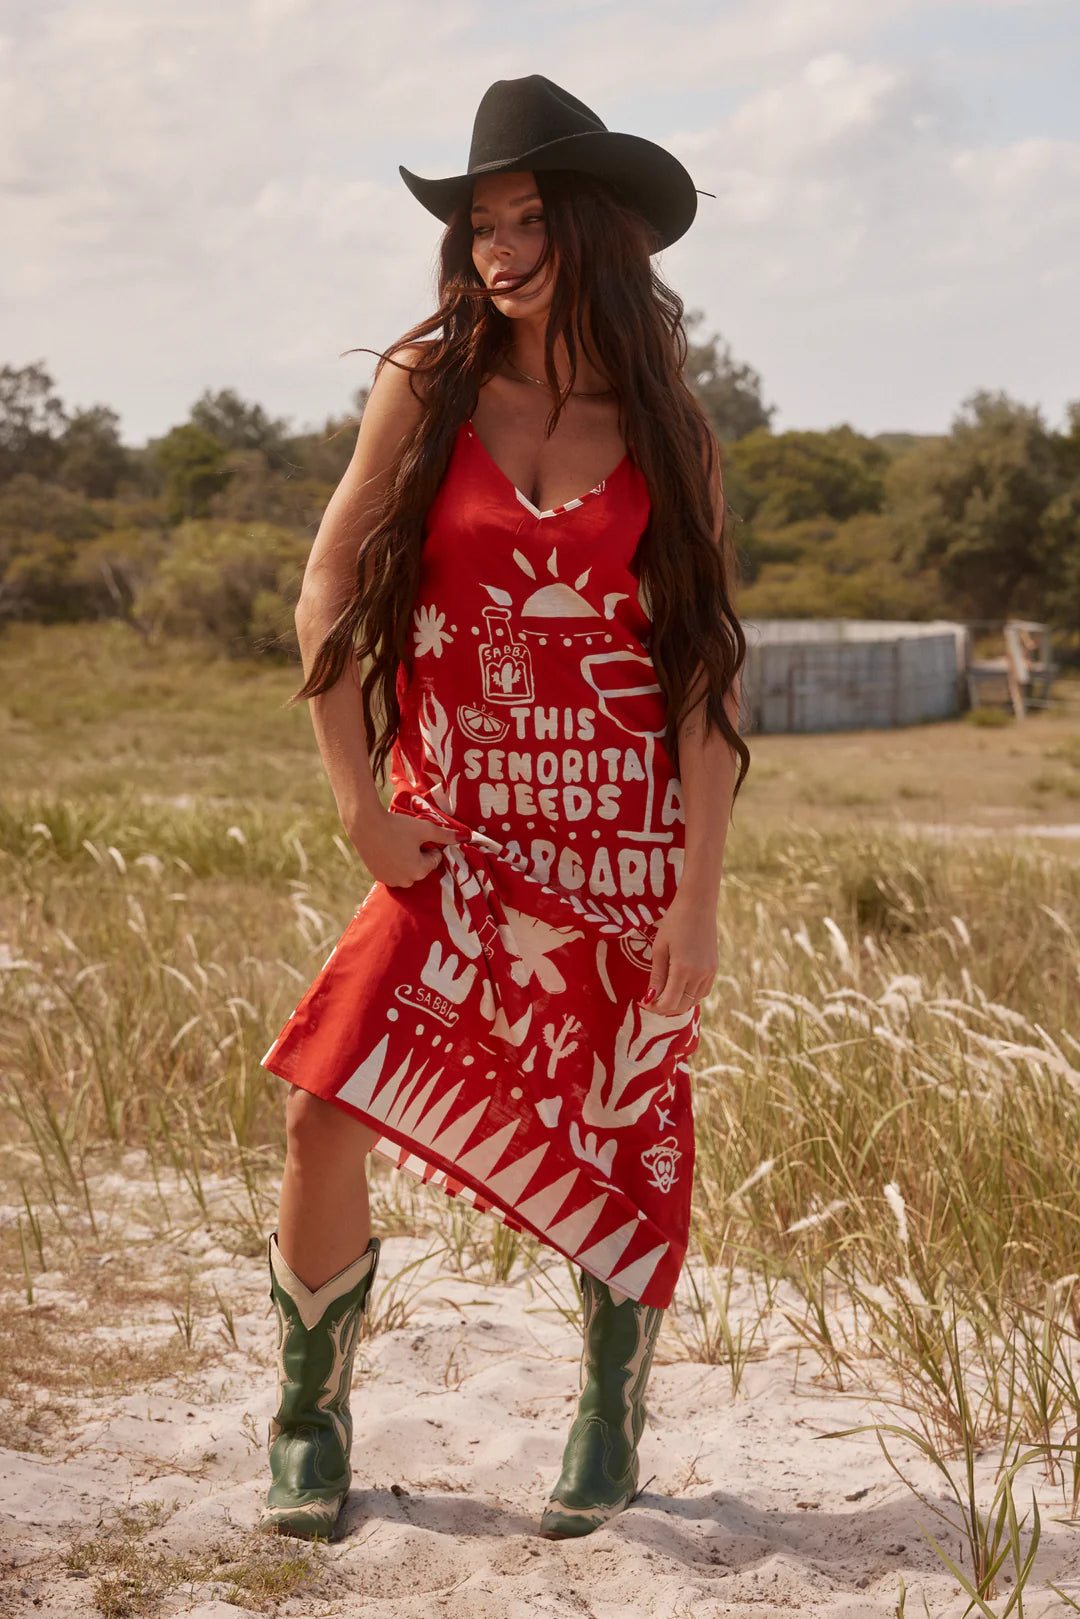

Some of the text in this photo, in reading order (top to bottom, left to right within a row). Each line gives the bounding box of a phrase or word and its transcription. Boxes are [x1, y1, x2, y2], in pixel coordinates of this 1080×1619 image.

[484, 645, 527, 661] SABBI
[510, 706, 596, 741] THIS
[463, 748, 646, 785] SENORITA
[478, 783, 622, 822] NEEDS
[416, 988, 453, 1018] SABBI
